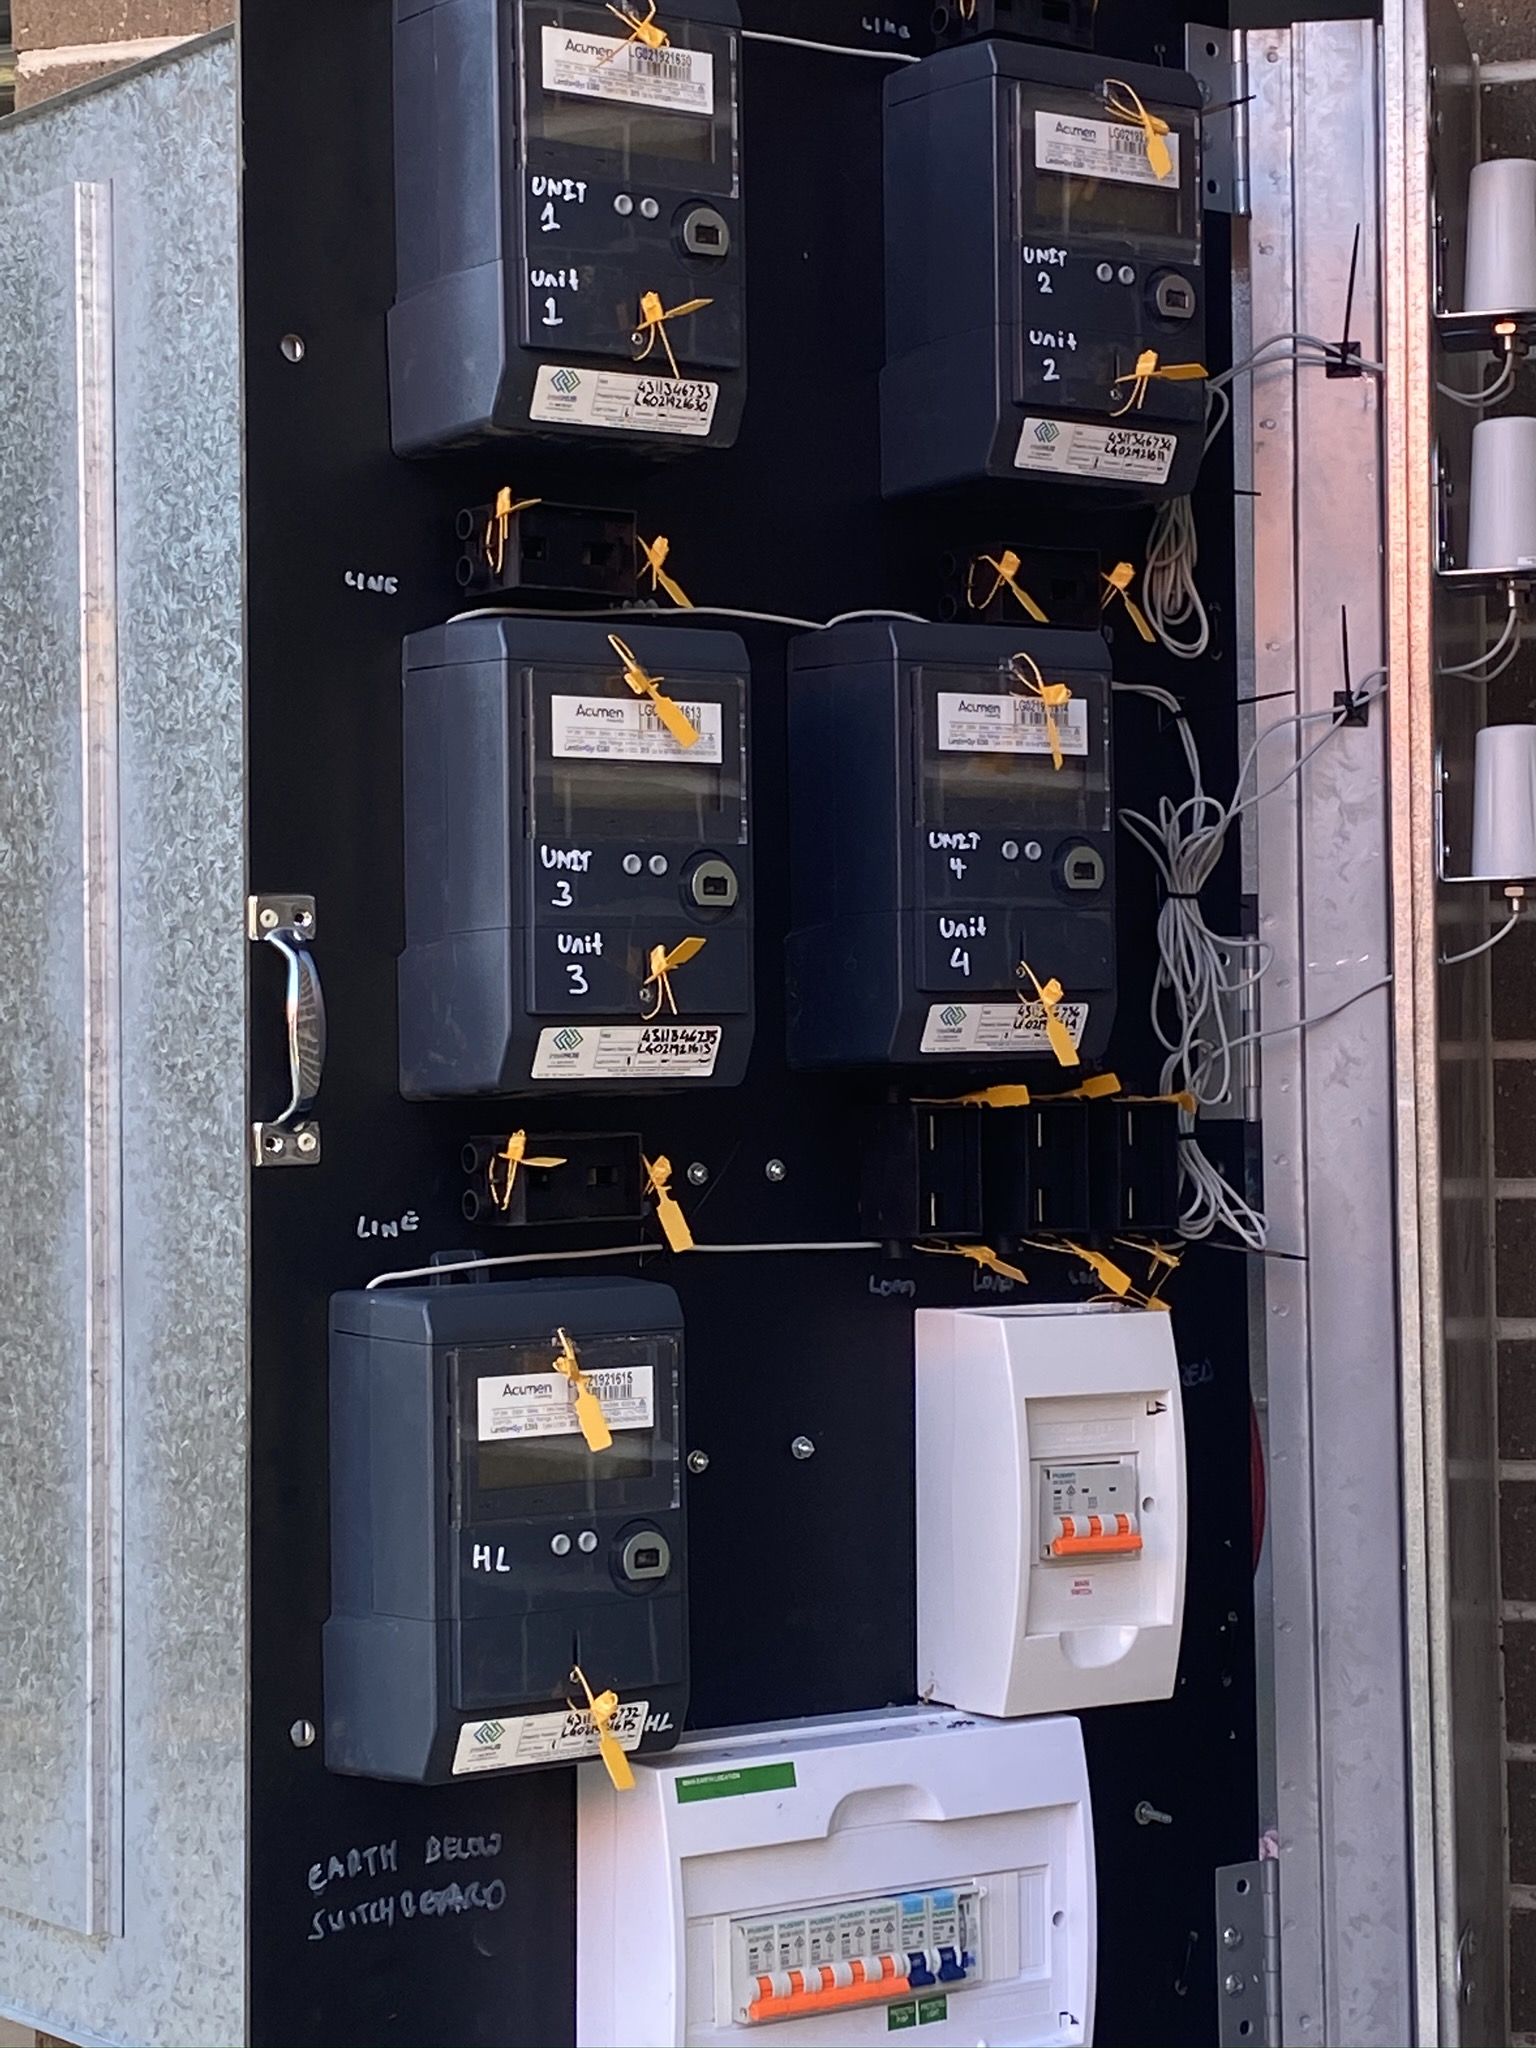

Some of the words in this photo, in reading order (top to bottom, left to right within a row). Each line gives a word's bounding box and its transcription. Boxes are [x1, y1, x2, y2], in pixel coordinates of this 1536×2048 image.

[565, 39, 614, 60] Acumen
[1056, 121, 1097, 138] Acumen
[532, 176, 588, 202] UNIT
[540, 202, 560, 231] 1
[1023, 246, 1067, 267] UNIT
[531, 269, 579, 291] Unit
[1037, 272, 1053, 294] 2
[542, 297, 563, 326] 1
[1029, 330, 1077, 351] Unit
[1042, 359, 1060, 381] 2
[344, 571, 398, 594] LINE
[575, 704, 624, 718] Acumen
[958, 700, 1001, 713] Acumen
[929, 831, 981, 850] UNIT
[540, 845, 592, 872] UNIT
[950, 857, 966, 879] 4
[551, 882, 573, 907] 3
[940, 916, 987, 938] Unit
[557, 932, 603, 956] Unit
[950, 948, 970, 975] 4
[568, 964, 588, 994] 3
[357, 1210, 420, 1238] LINE
[1068, 1268, 1104, 1292] LOA
[502, 1383, 552, 1398] Acumen
[472, 1544, 511, 1573] HL
[645, 1712, 674, 1732] HL
[308, 1840, 397, 1891] EARTH
[425, 1833, 502, 1864] BELOW
